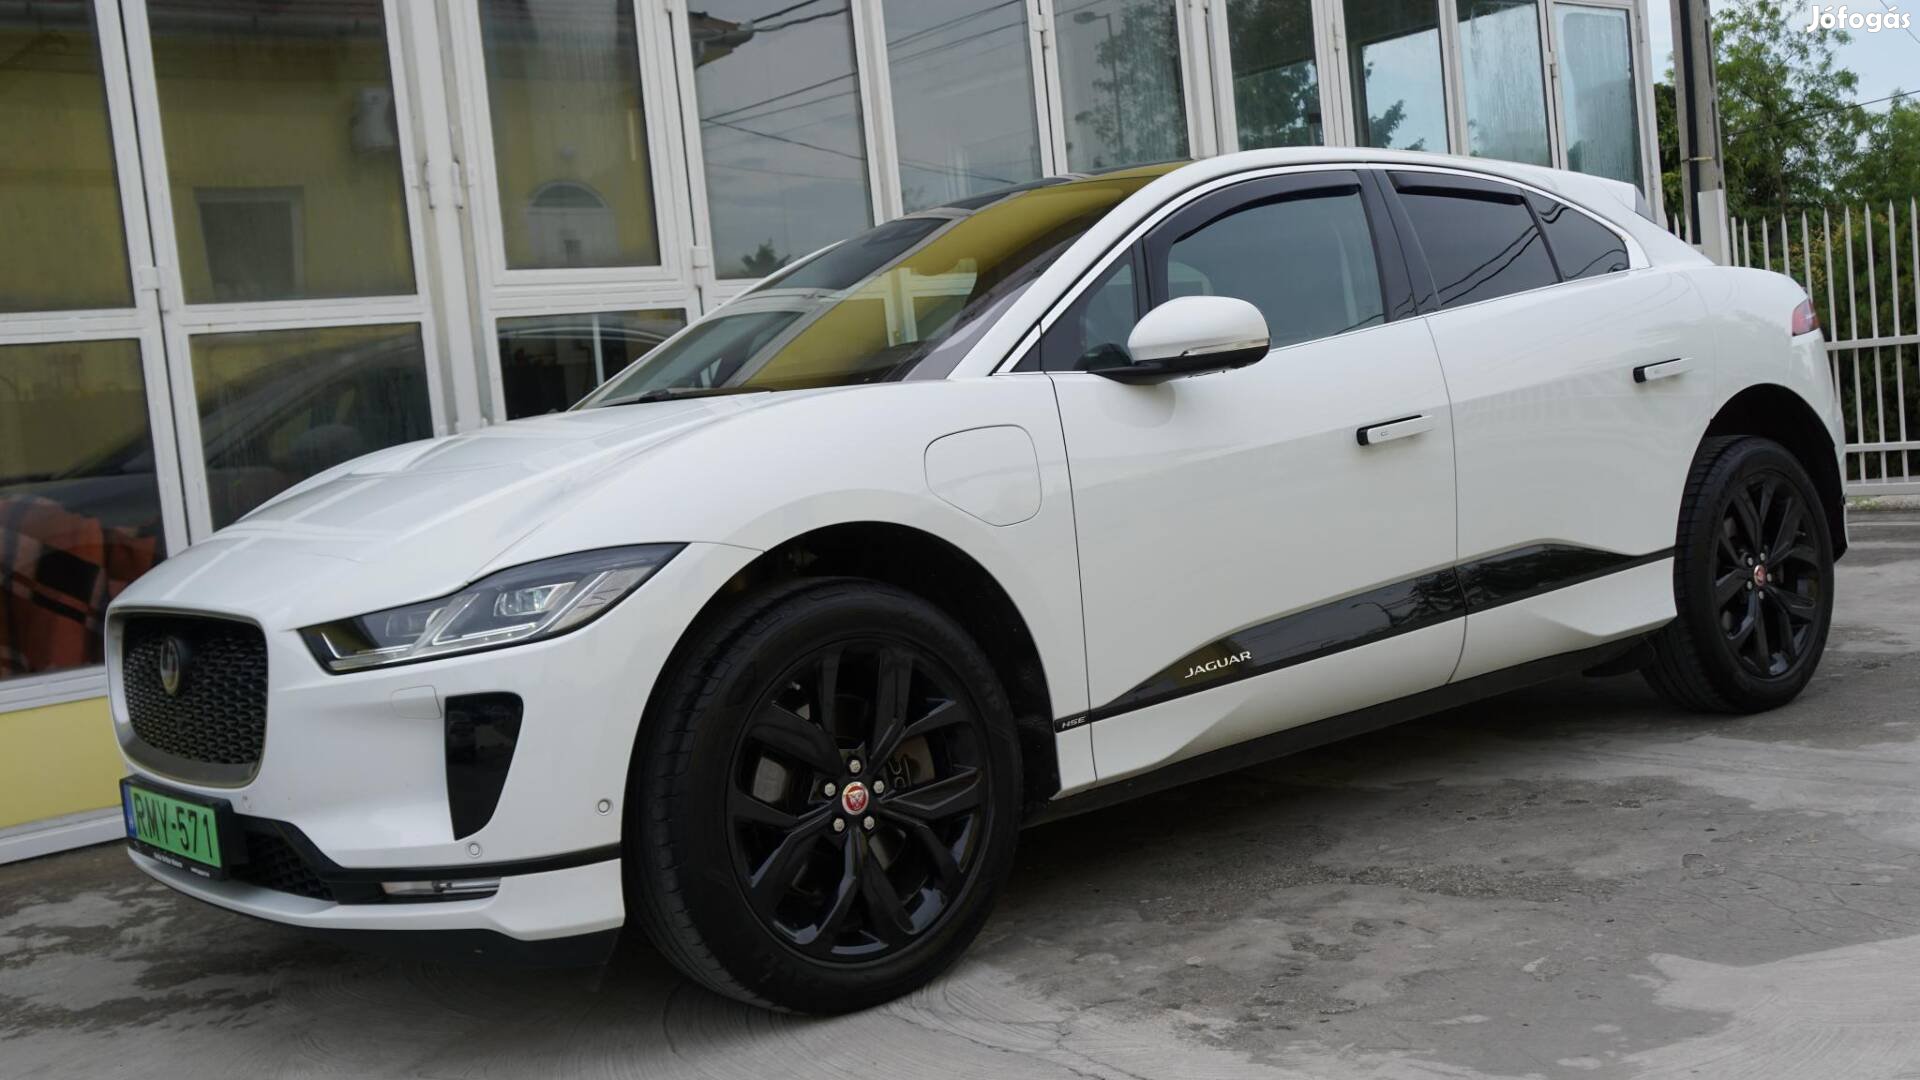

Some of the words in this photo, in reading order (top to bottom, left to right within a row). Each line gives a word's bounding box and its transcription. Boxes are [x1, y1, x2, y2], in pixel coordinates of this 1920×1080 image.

[1184, 650, 1252, 679] JAGUAR
[1061, 716, 1087, 729] HSE
[133, 792, 213, 859] RMY-571
